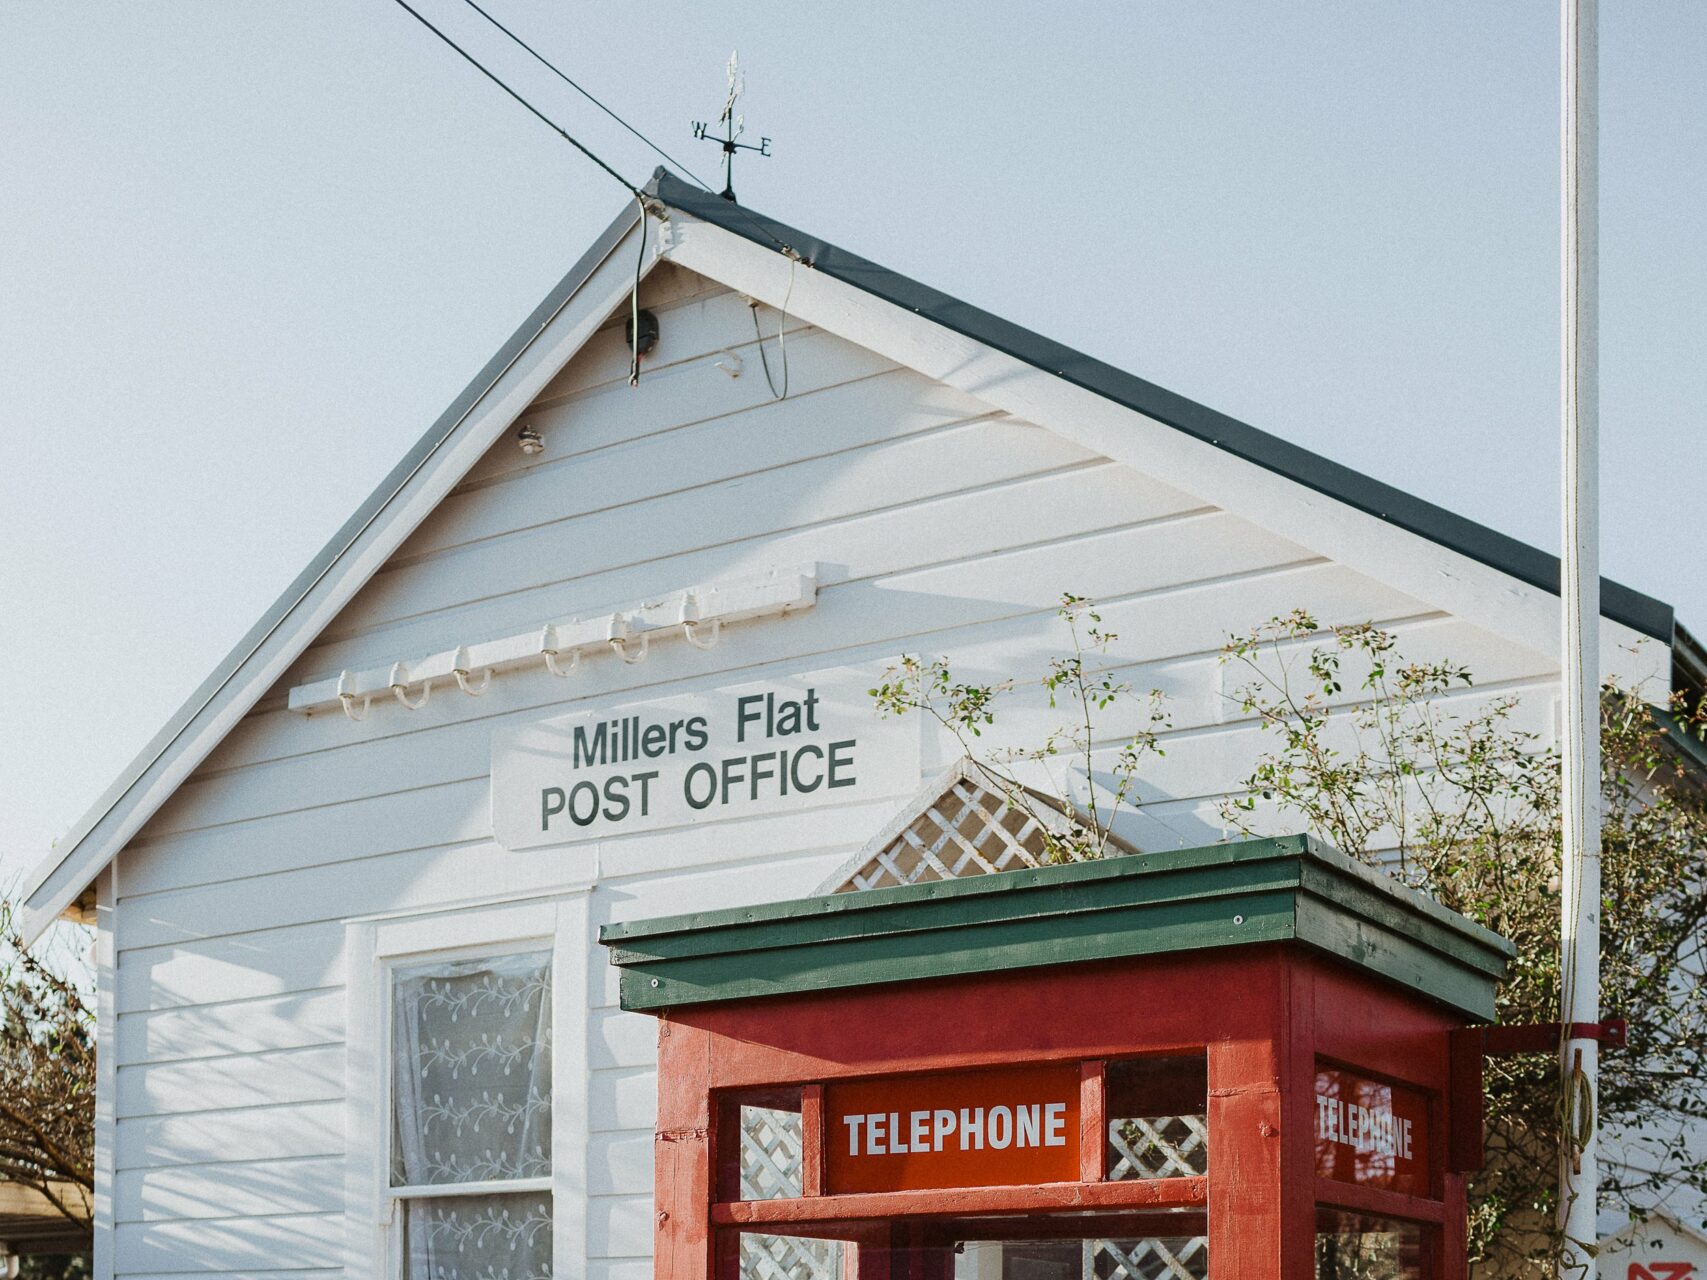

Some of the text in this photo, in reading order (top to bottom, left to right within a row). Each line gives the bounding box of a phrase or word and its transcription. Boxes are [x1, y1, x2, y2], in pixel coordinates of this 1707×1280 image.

[690, 120, 707, 140] W
[761, 137, 772, 157] E
[573, 688, 820, 769] Millers Flat
[541, 739, 857, 831] POST OFFICE
[843, 1102, 1066, 1156] TELEPHONE
[1316, 1094, 1412, 1160] TELEPHONE
